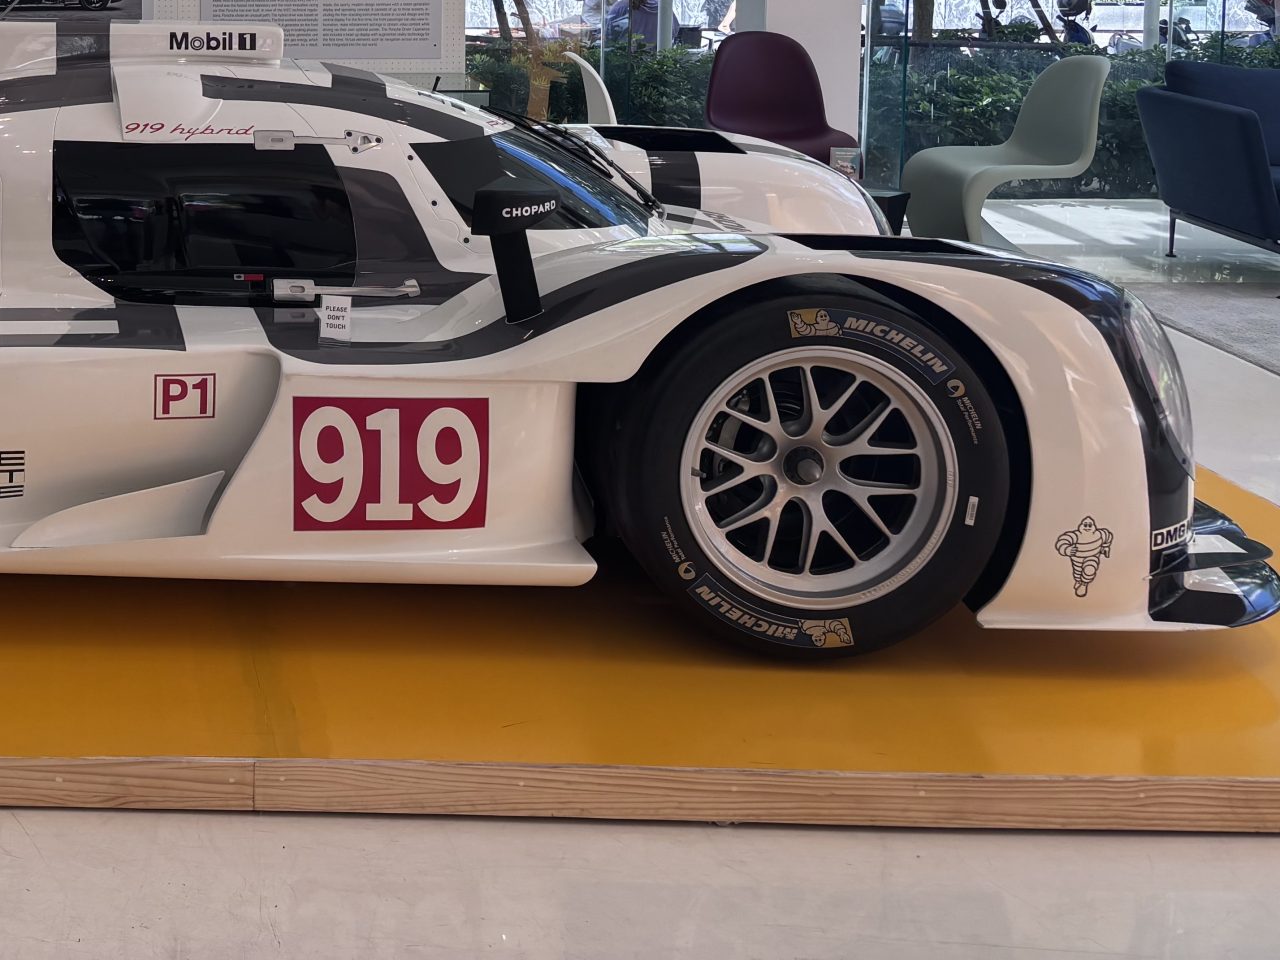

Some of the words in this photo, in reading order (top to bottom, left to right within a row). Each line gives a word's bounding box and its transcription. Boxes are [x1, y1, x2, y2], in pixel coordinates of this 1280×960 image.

[169, 32, 234, 51] Mobil
[125, 122, 164, 135] 919
[167, 123, 255, 142] hybrid
[502, 200, 556, 218] CHOPARD
[843, 316, 948, 374] MICHELIN
[162, 377, 208, 415] P1
[962, 397, 982, 429] MICHELIN
[299, 406, 480, 523] 919
[1153, 523, 1186, 548] DMG
[693, 585, 798, 641] MICHELIN
